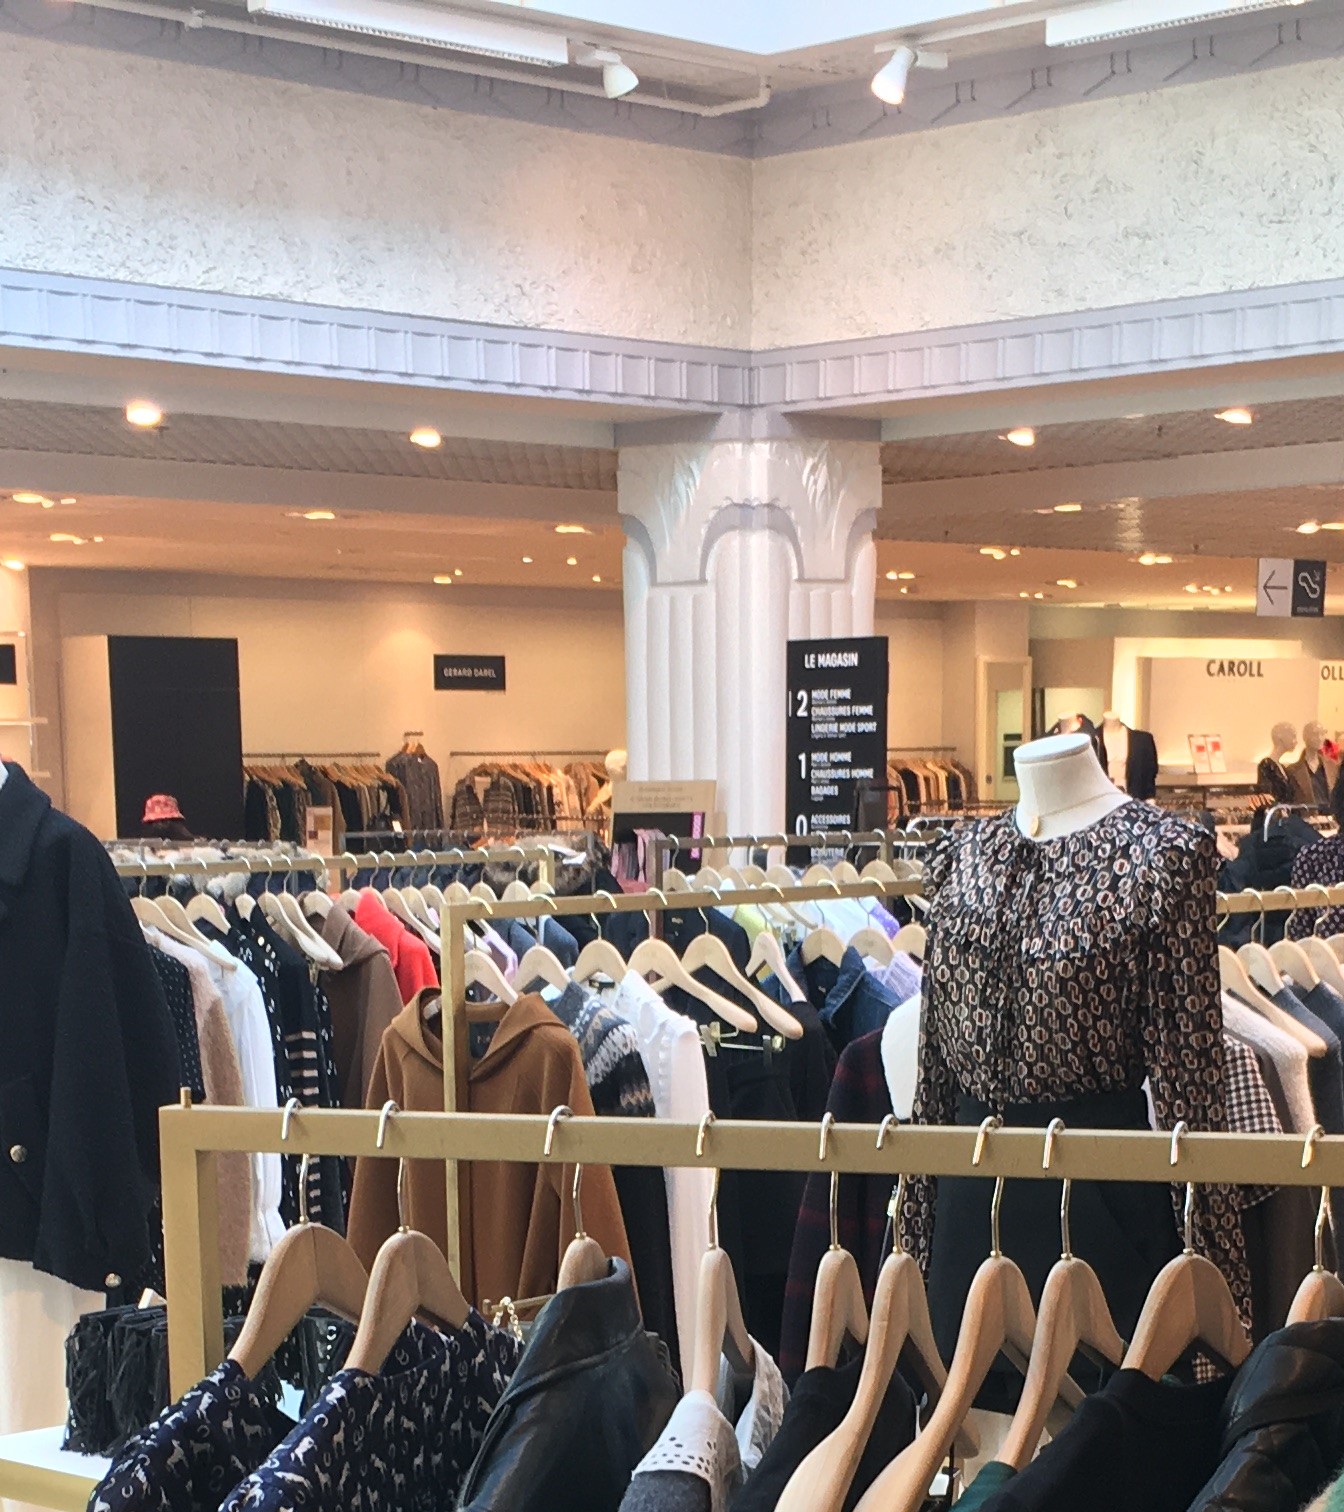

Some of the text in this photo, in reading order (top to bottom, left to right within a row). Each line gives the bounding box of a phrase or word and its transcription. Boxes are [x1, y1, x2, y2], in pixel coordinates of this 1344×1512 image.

[804, 652, 859, 669] LE MAGASIN
[1206, 660, 1264, 677] CAROLL
[796, 689, 808, 718] 2
[851, 704, 874, 717] FEMME
[798, 752, 807, 780] 1
